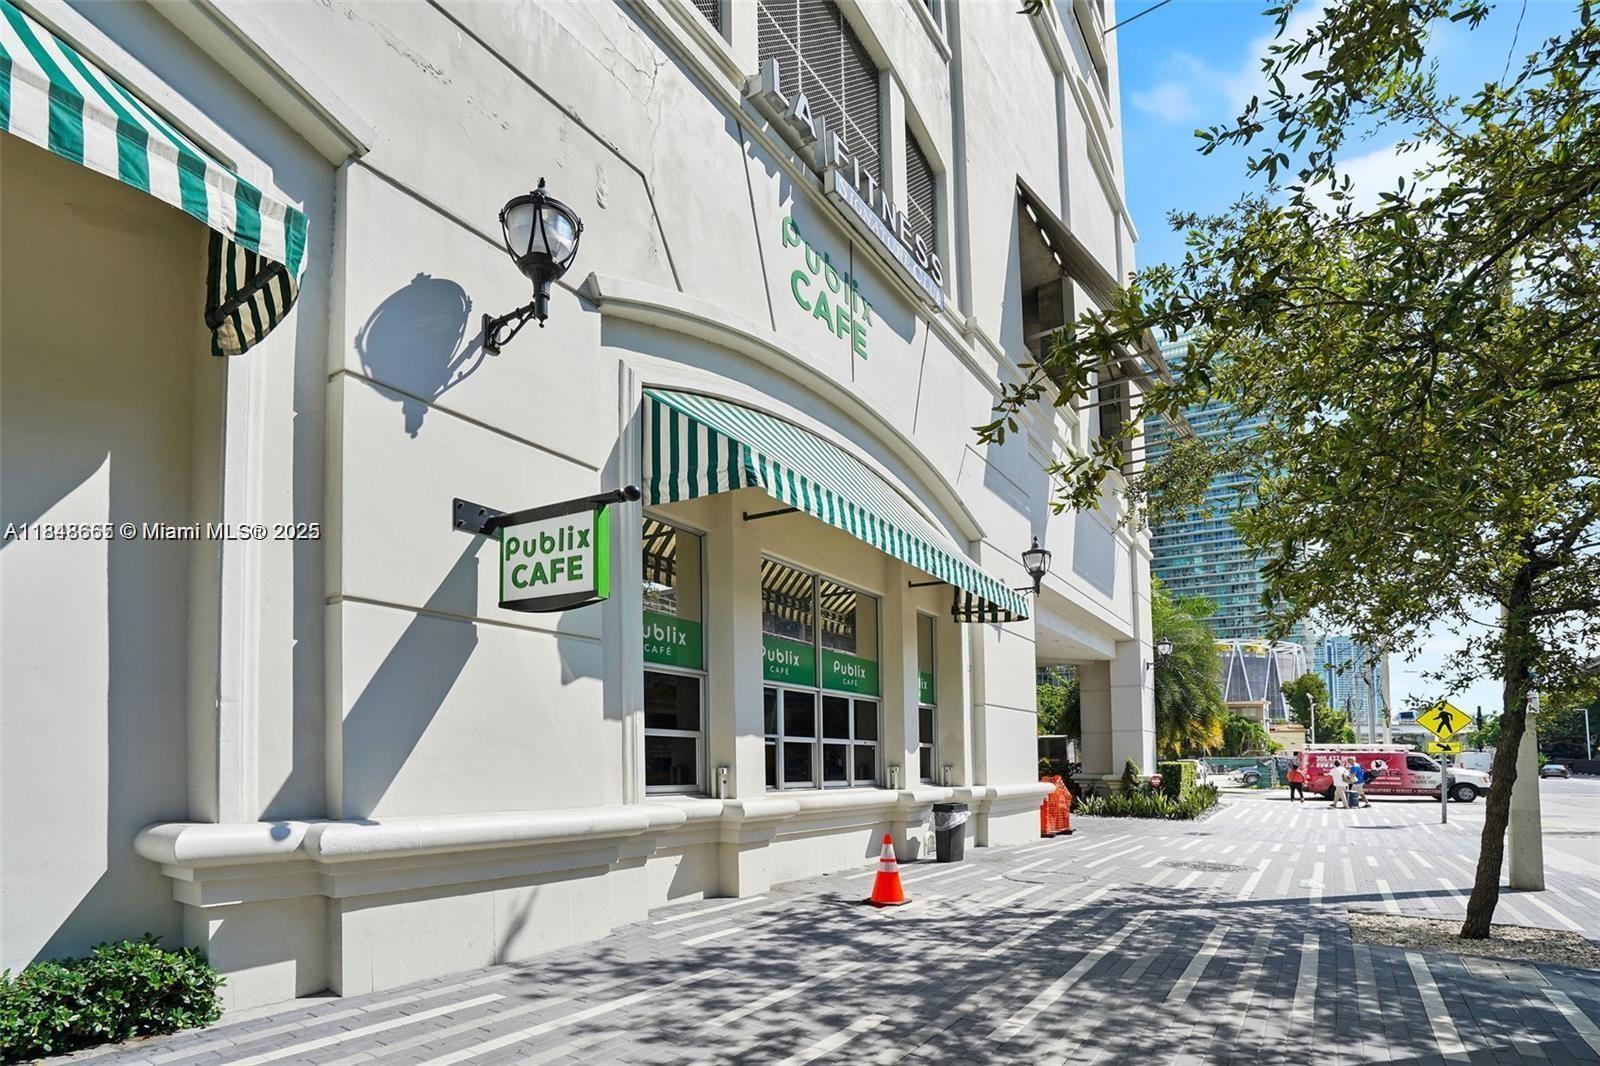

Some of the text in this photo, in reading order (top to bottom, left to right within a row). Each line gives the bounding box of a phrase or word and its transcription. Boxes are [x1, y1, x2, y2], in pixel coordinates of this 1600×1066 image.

[772, 57, 944, 288] LA FITNESS
[782, 216, 873, 327] Publix
[790, 269, 868, 361] CAFE
[505, 525, 591, 561] Publix
[511, 554, 584, 589] CAFE
[643, 623, 687, 646] ublix
[833, 660, 866, 679] Publix
